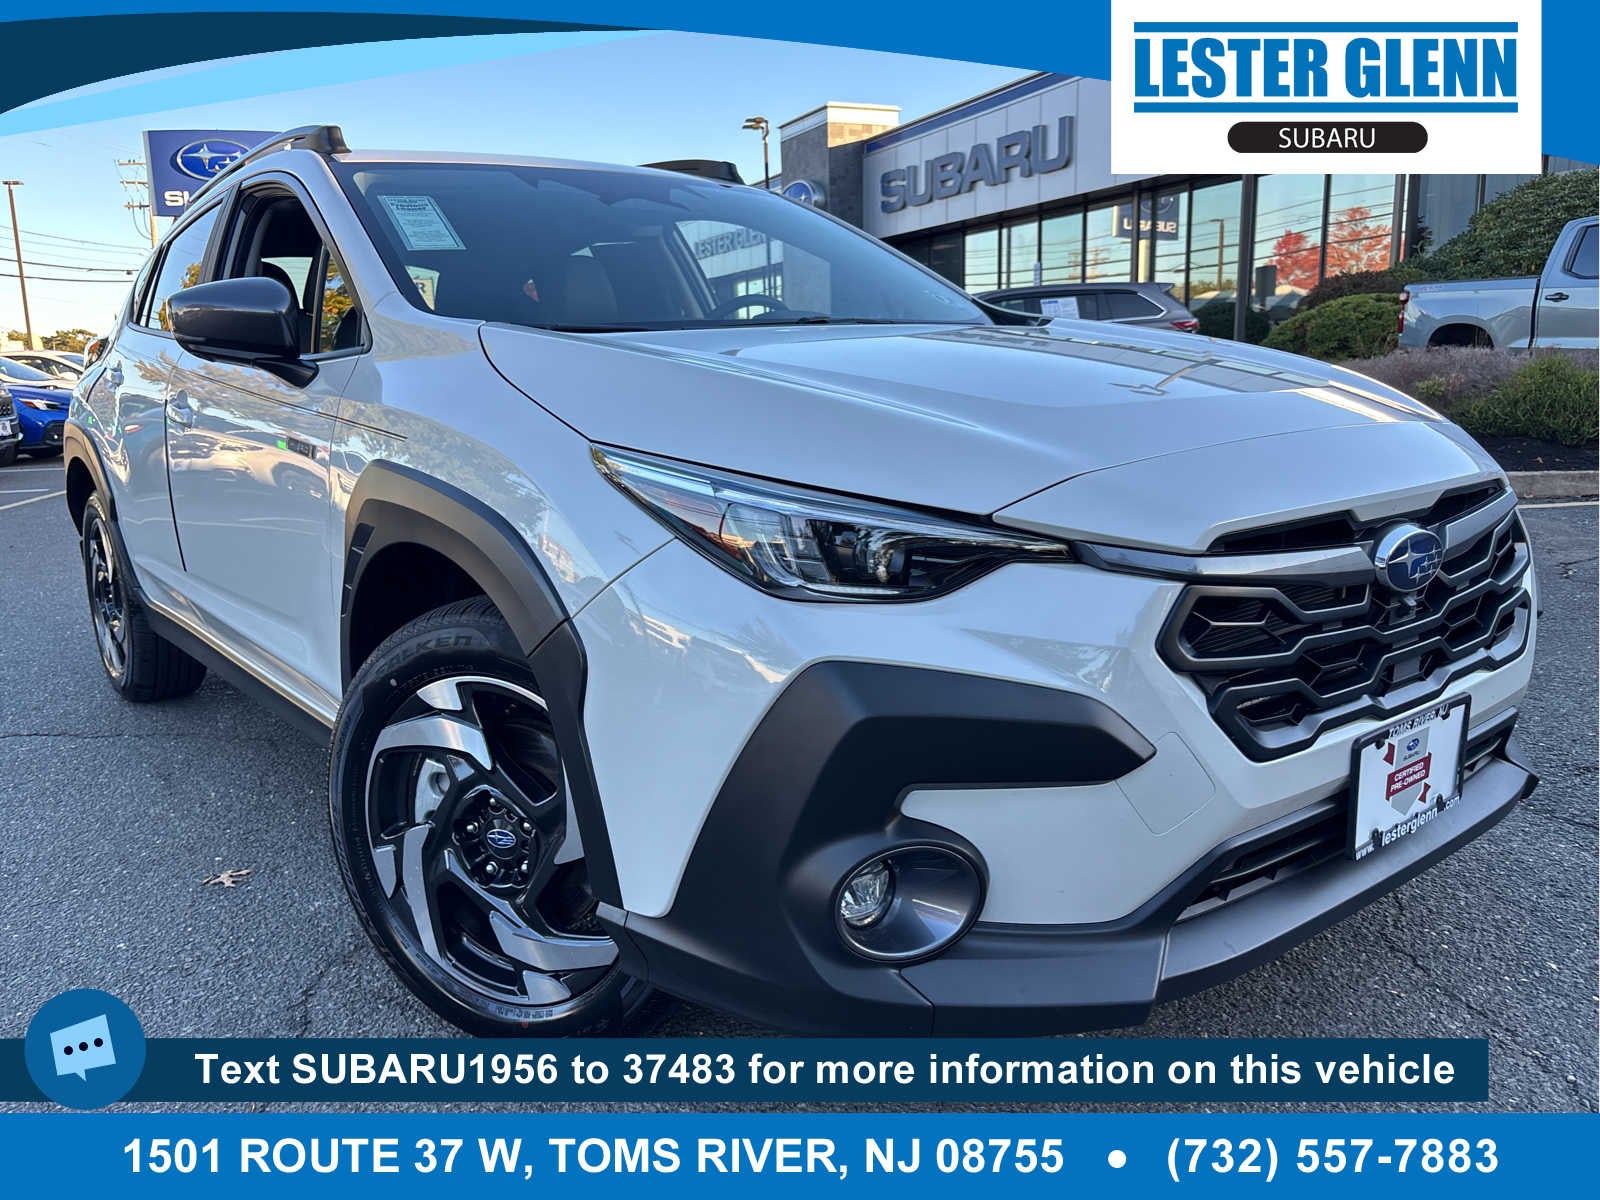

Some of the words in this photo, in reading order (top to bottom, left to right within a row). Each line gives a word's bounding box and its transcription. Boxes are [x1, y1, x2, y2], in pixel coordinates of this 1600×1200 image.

[881, 115, 1074, 213] SUBARU
[1390, 769, 1426, 792] PRE-OWNED
[1394, 762, 1424, 781] CERTIFIED
[1382, 806, 1438, 846] lesterglenn
